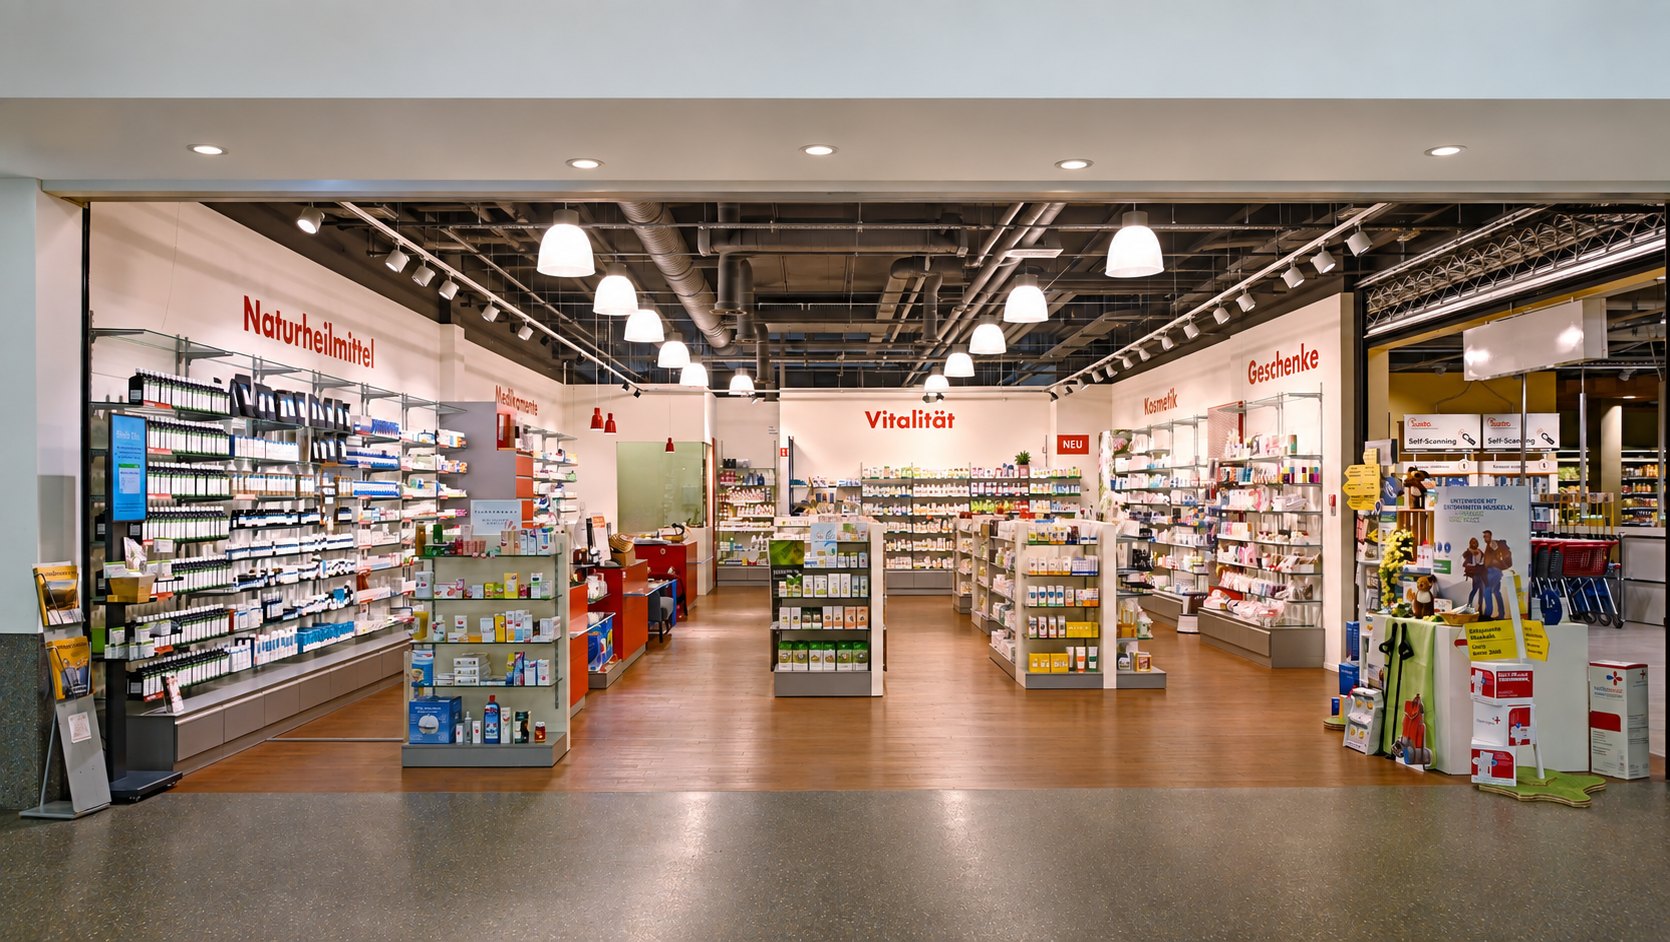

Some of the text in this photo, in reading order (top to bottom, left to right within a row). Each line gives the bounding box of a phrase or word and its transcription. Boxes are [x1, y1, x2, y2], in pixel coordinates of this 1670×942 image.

[243, 295, 375, 369] Naturheilmittel
[1248, 343, 1320, 385] Geschenke
[495, 385, 538, 416] Medikamente
[1144, 387, 1178, 415] Kosmetik
[865, 410, 955, 429] Vitalität
[1062, 439, 1083, 449] NEU
[1408, 437, 1457, 446] Self-Scanning
